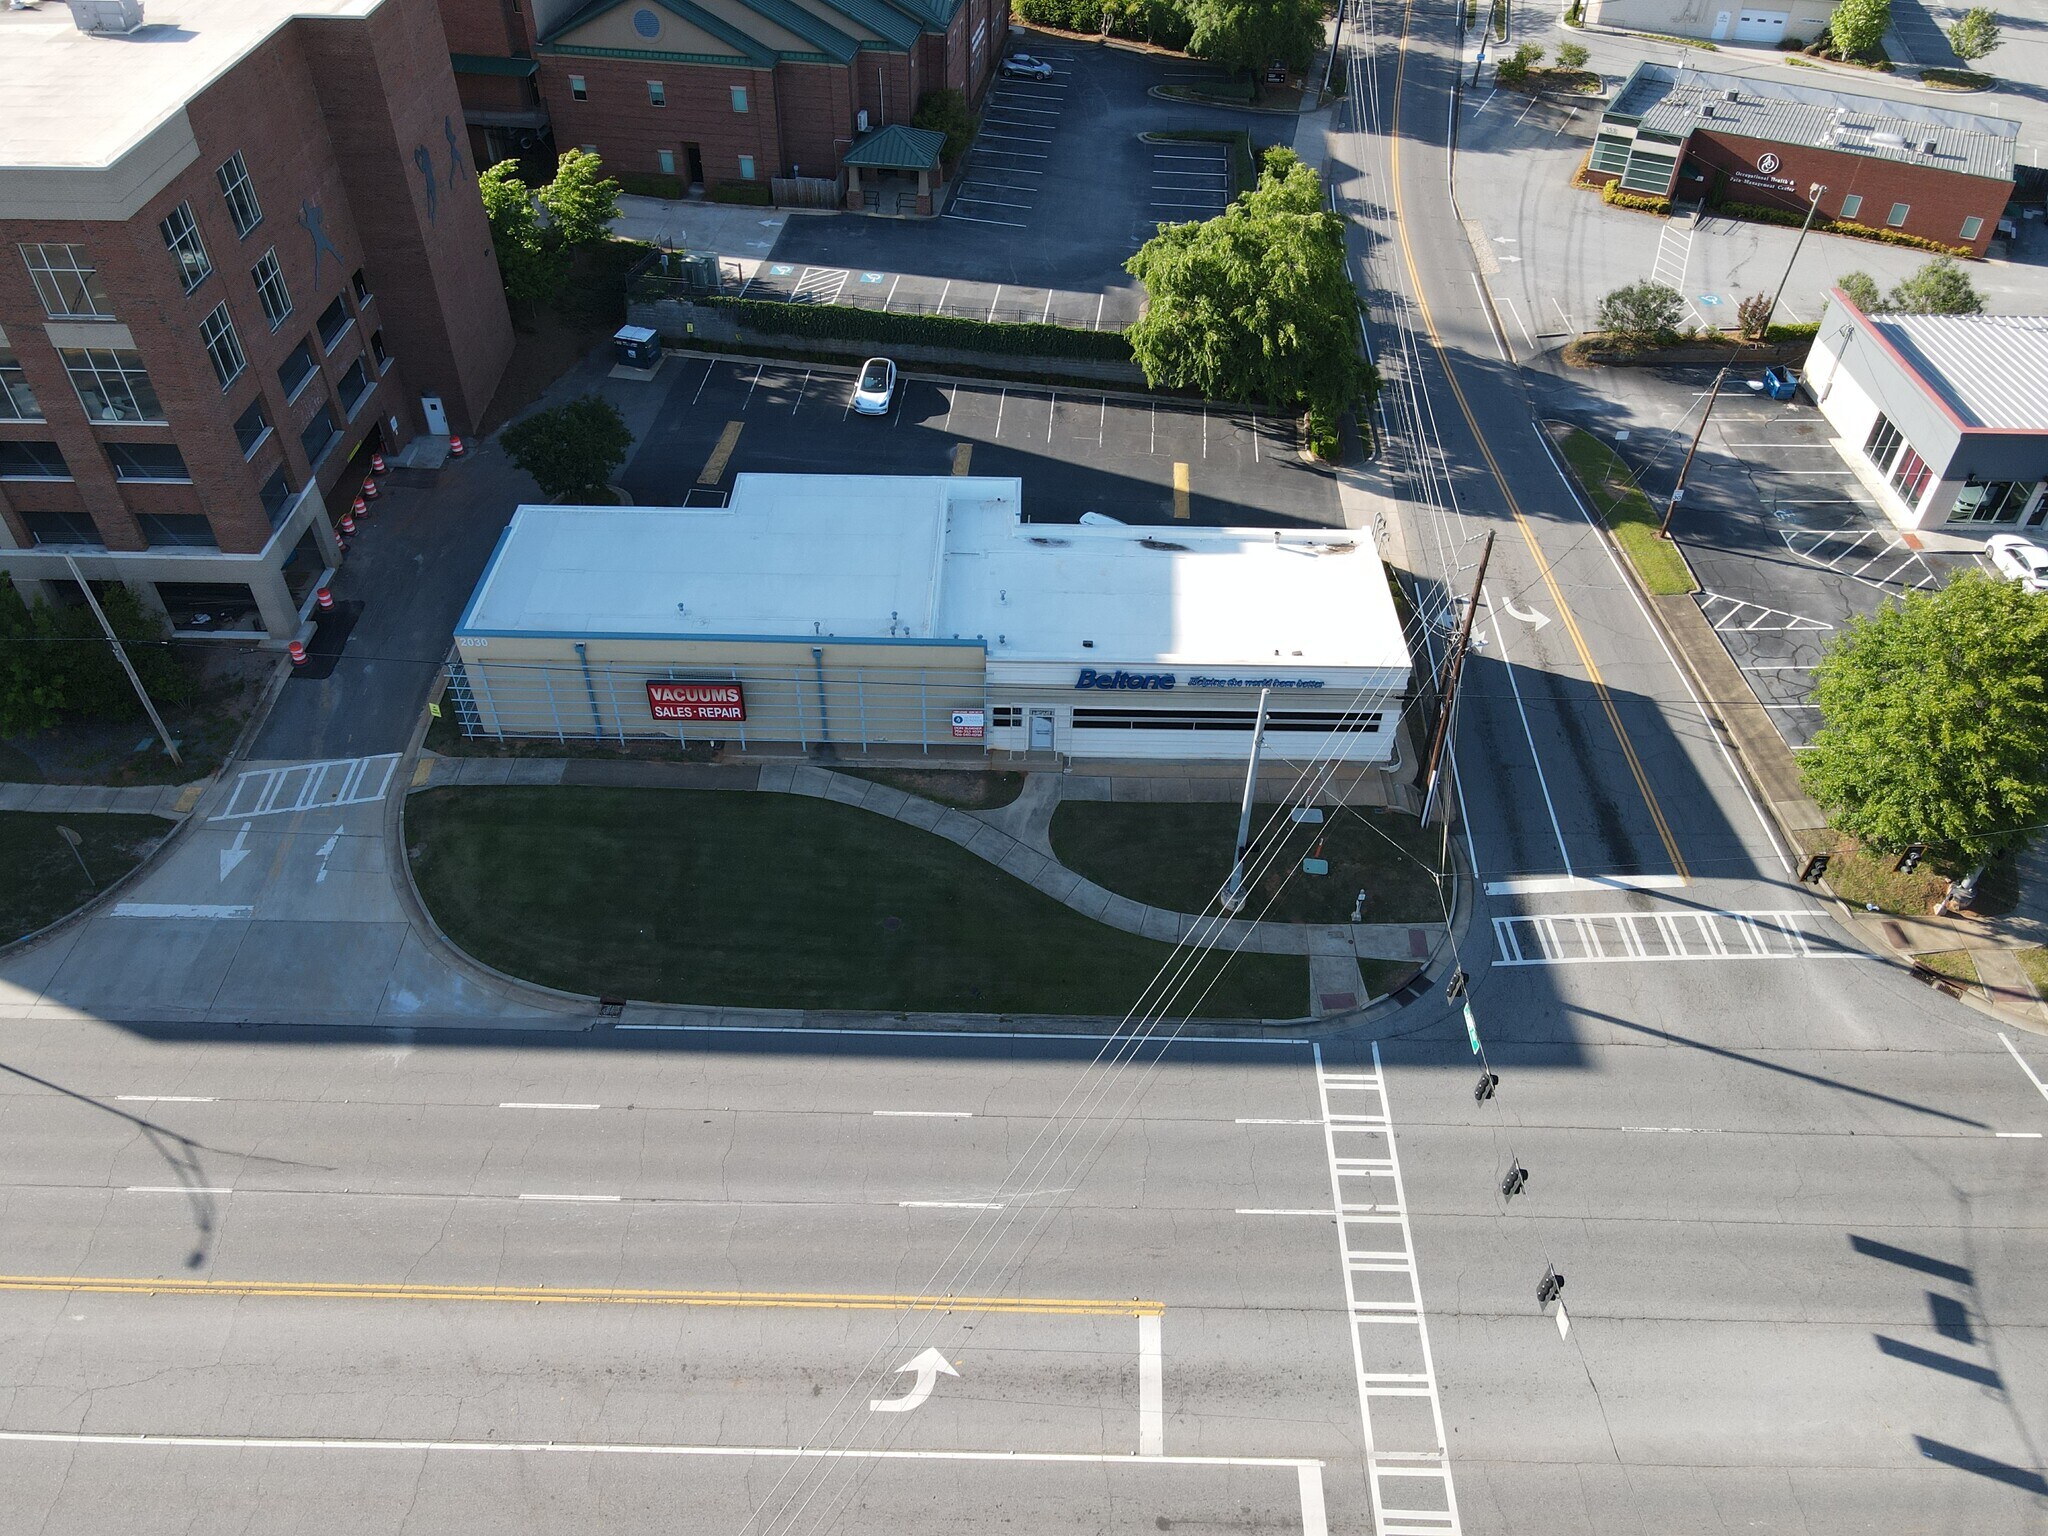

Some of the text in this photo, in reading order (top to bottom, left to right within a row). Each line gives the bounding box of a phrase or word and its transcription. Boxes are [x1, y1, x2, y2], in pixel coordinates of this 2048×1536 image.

[1770, 176, 1788, 185] Health
[460, 638, 488, 646] 2030
[1075, 668, 1176, 690] Beltone
[1227, 678, 1243, 687] the
[650, 688, 739, 702] VACUUMS
[655, 707, 741, 718] SALES REPAIR
